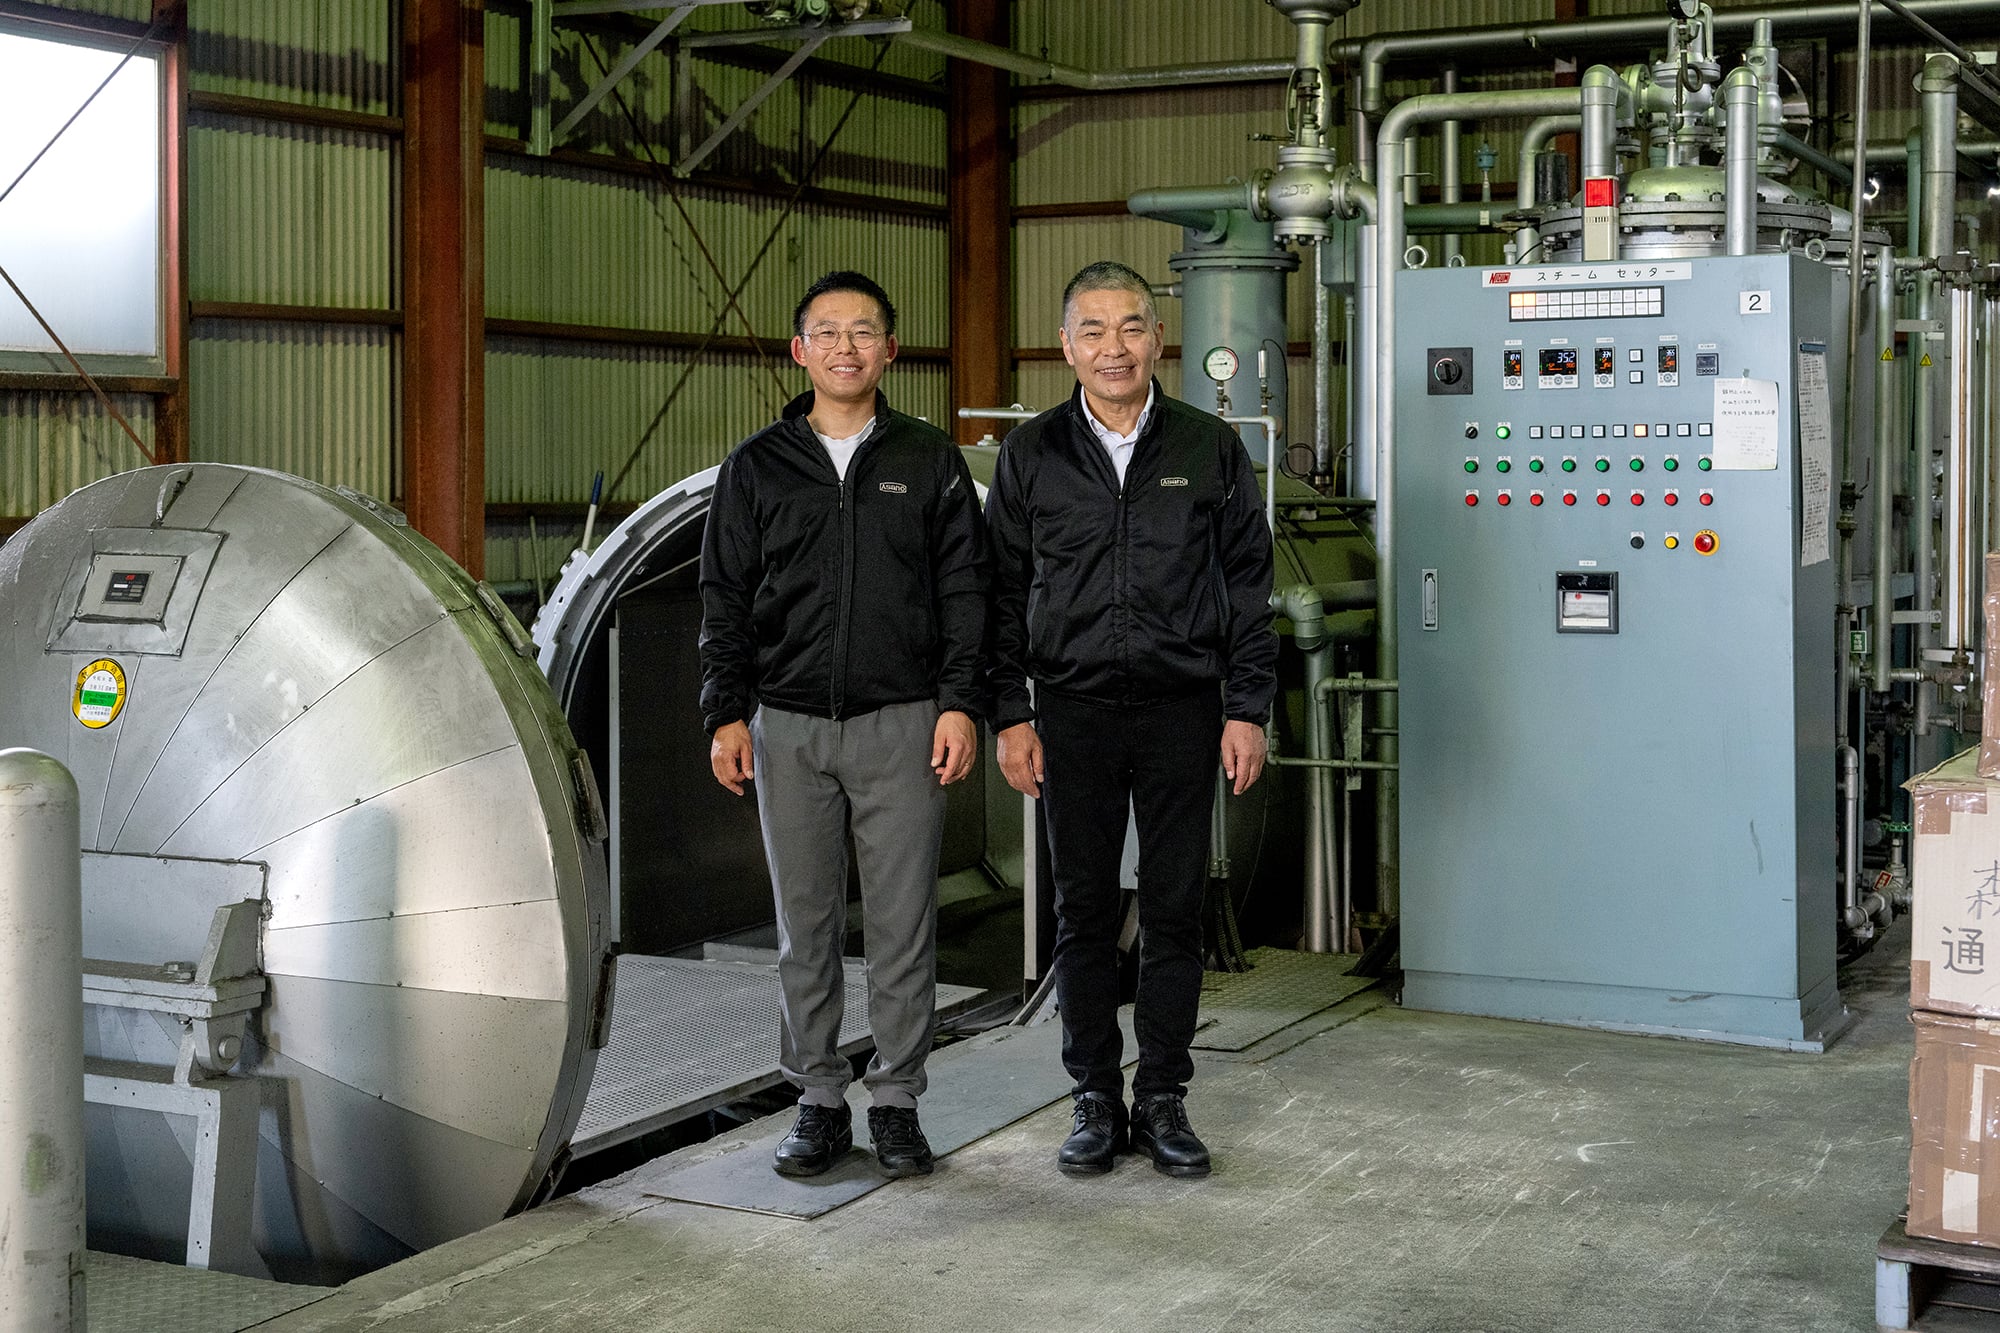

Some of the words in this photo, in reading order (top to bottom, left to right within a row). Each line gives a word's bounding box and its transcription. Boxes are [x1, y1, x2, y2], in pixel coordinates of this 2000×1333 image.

[1537, 271, 1597, 281] スチーム
[1617, 268, 1675, 279] セッター
[1749, 294, 1762, 311] 2
[1941, 926, 1985, 974] 通
